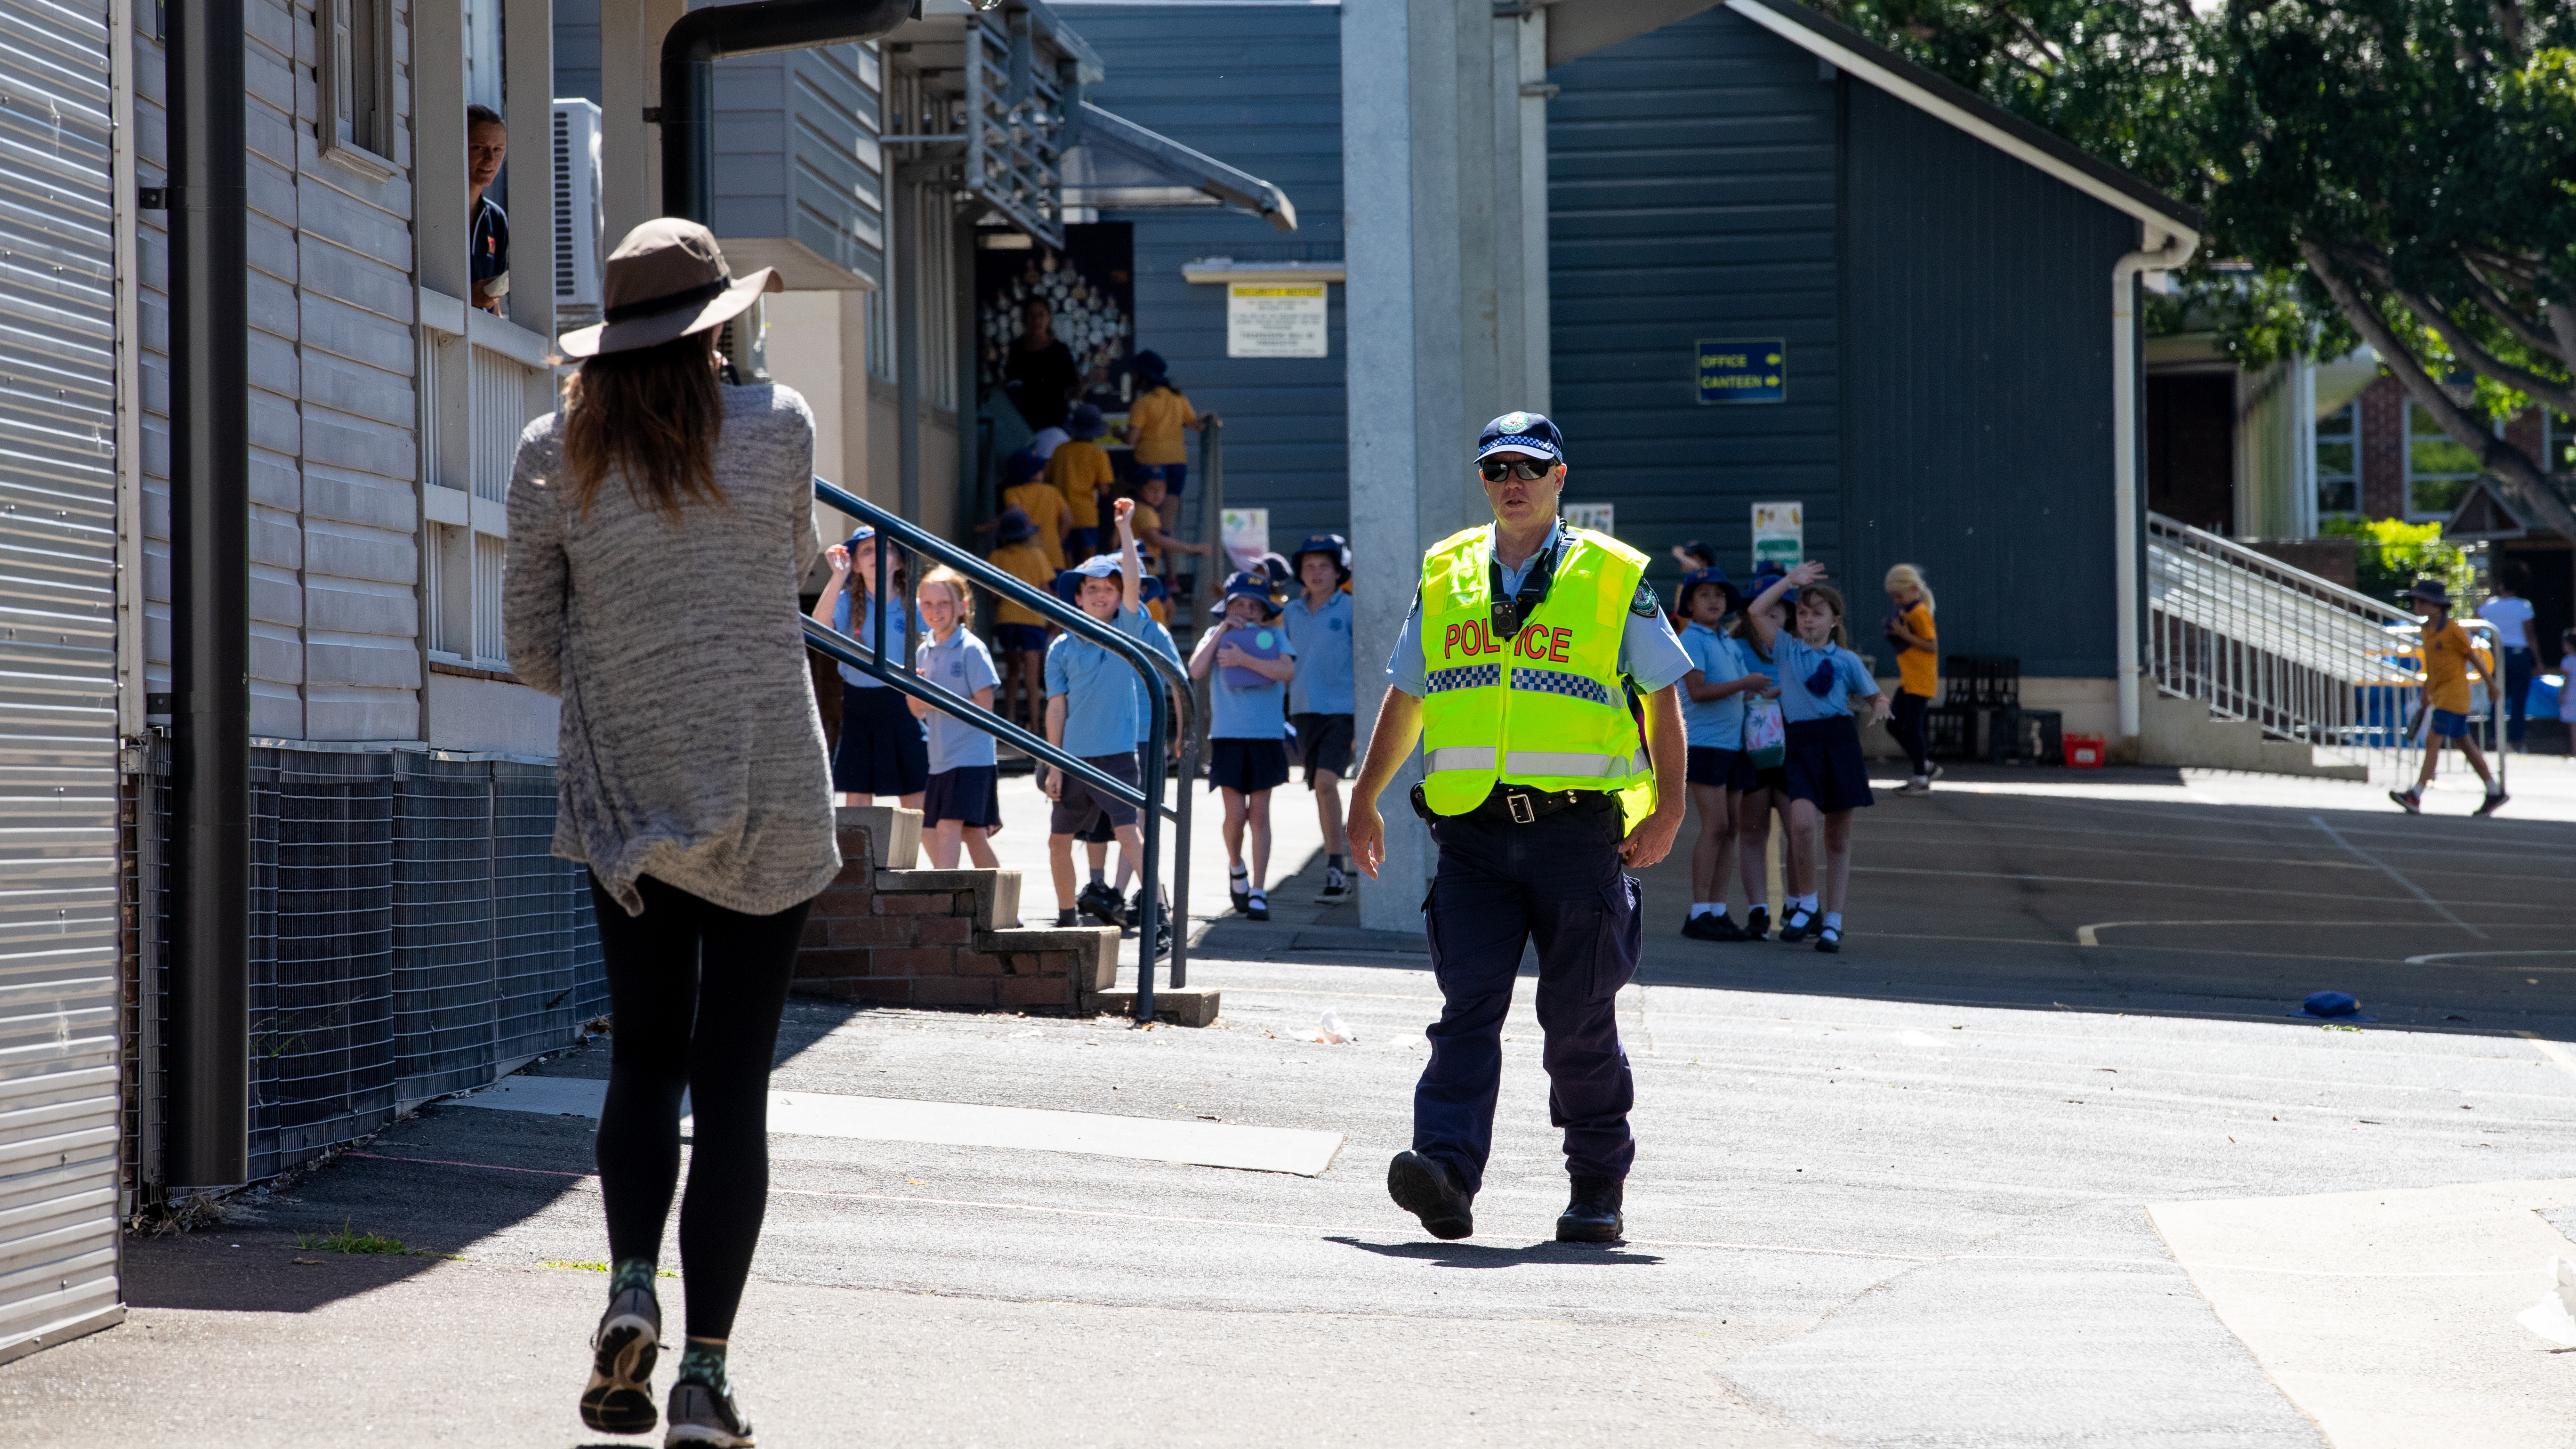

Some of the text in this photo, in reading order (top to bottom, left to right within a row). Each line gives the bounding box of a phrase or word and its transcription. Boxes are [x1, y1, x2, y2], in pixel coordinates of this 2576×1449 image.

[1701, 354, 1747, 368] OFFICE
[1702, 375, 1762, 389] CANTEEN
[1445, 618, 1573, 663] POLICE
